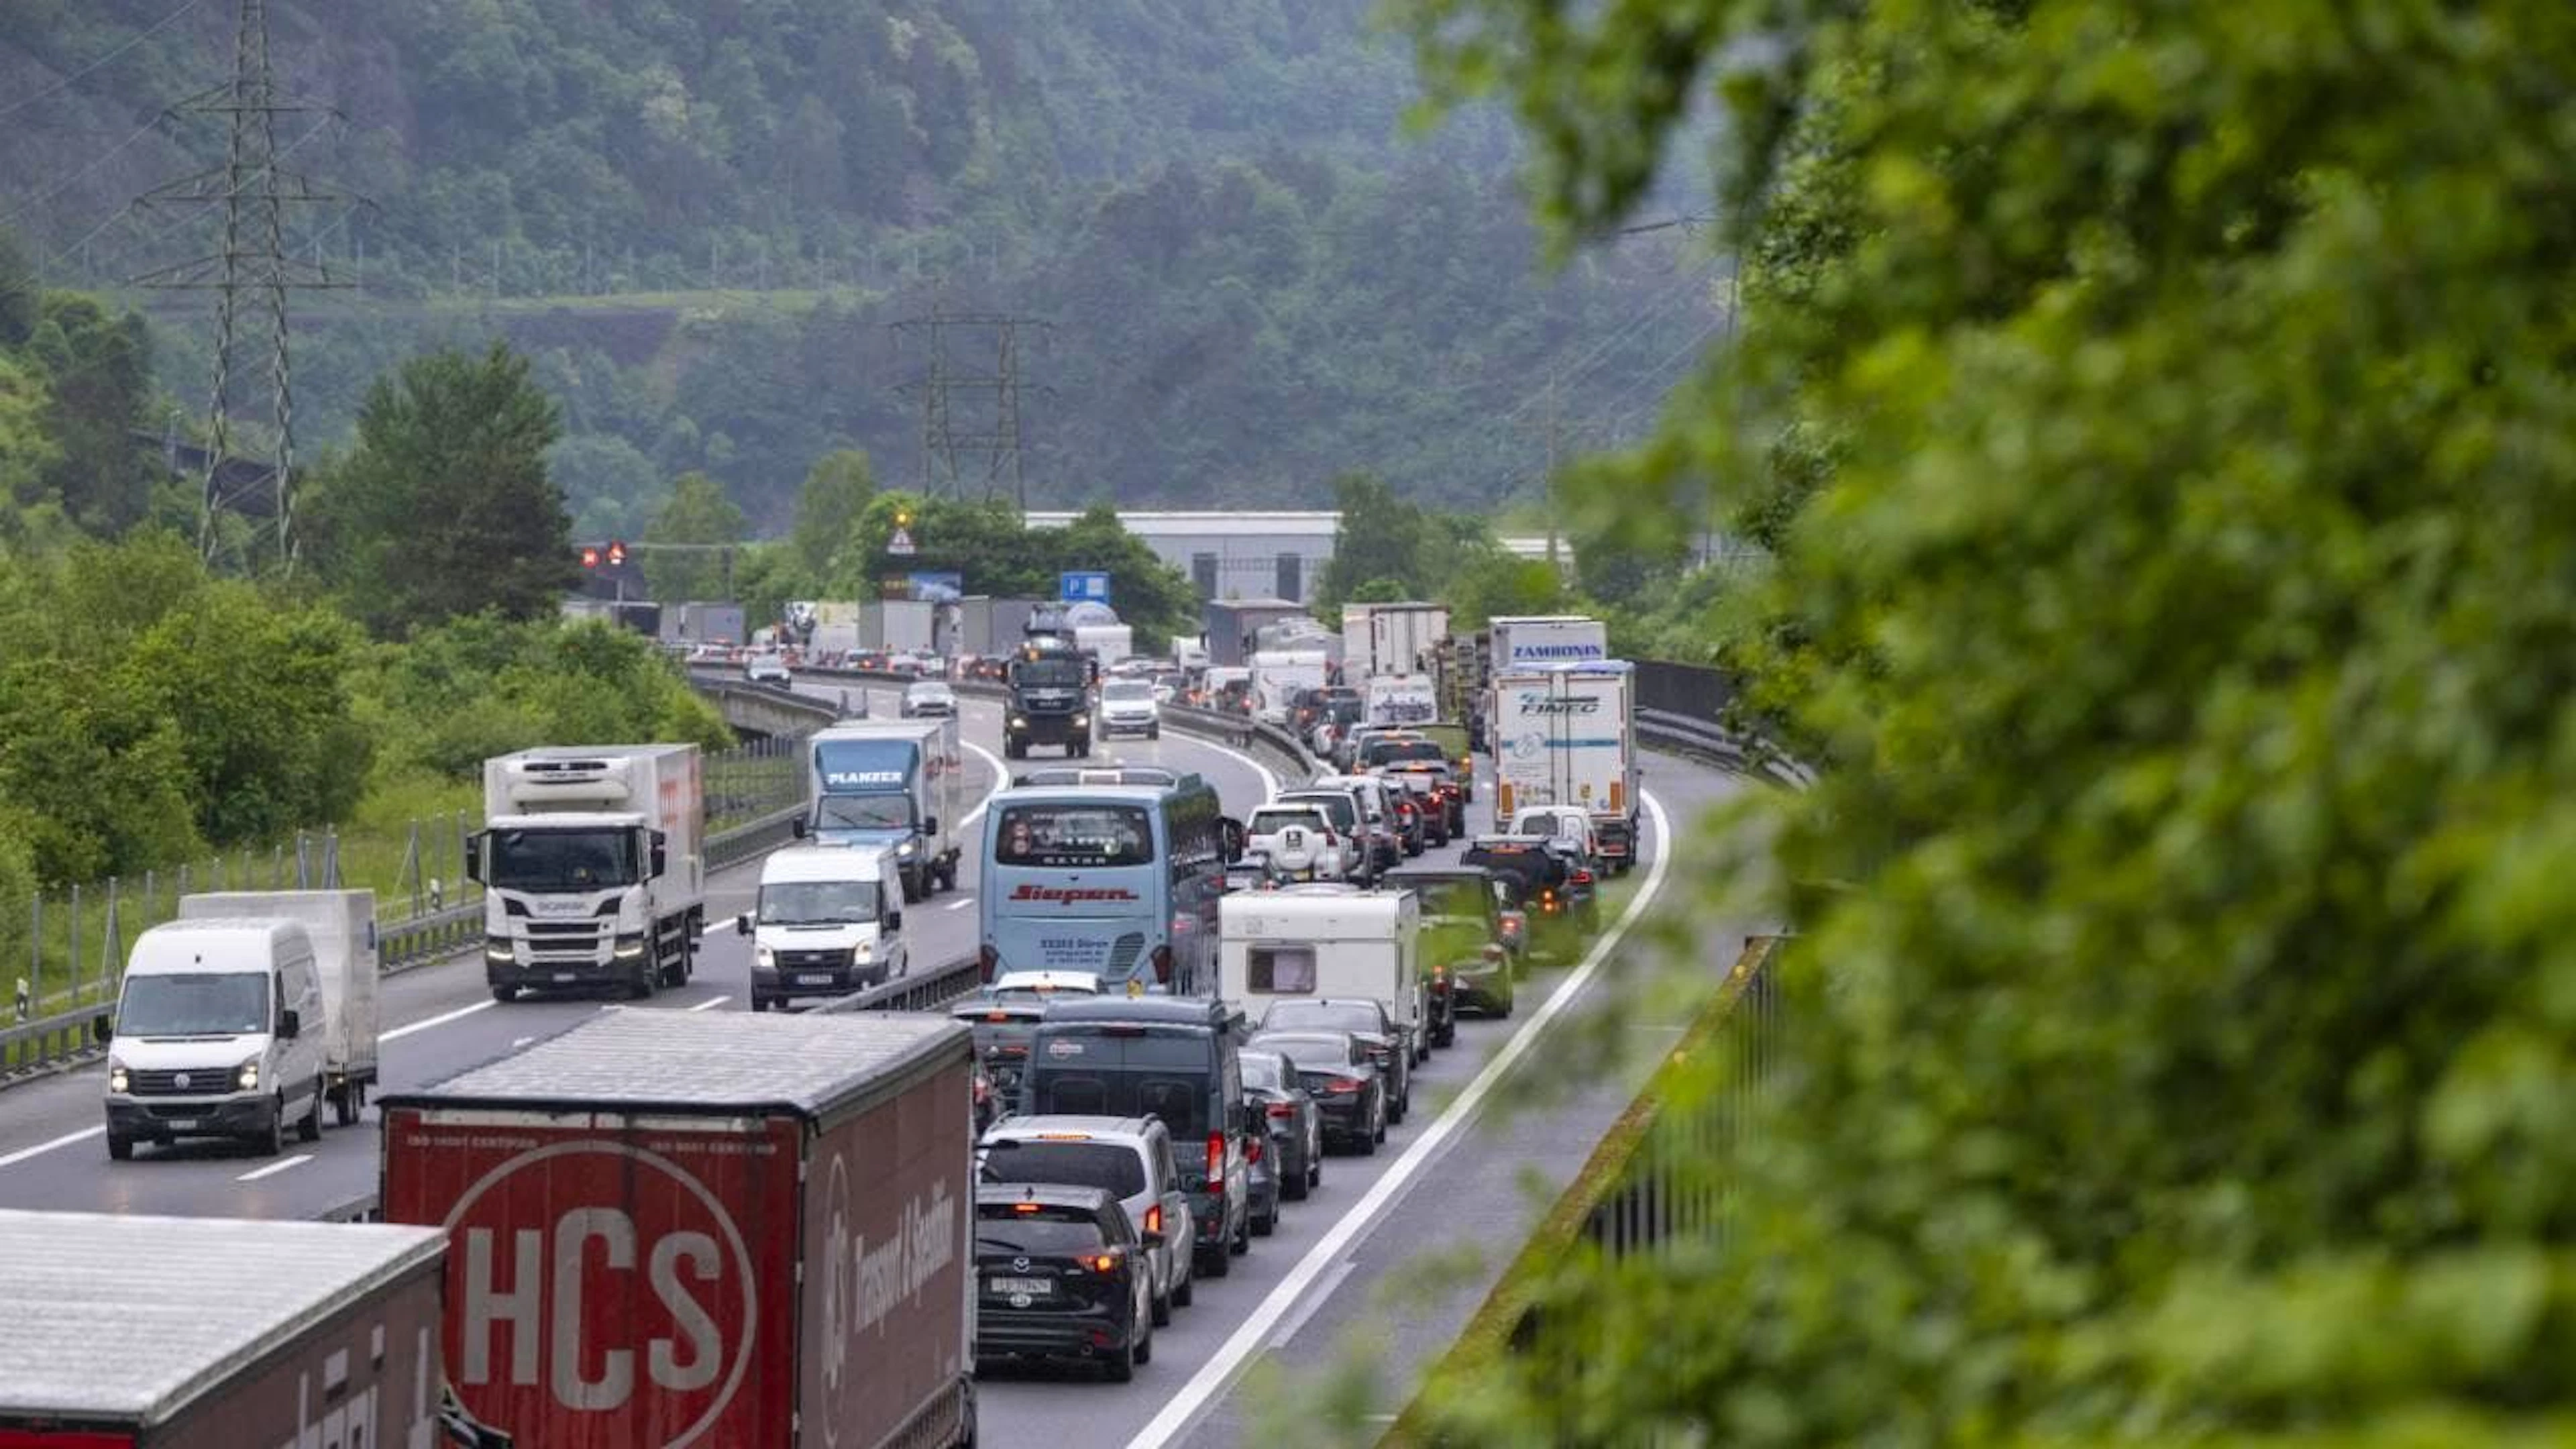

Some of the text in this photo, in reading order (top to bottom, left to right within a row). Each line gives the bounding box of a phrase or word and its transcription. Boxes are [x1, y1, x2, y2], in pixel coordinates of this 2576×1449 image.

[1513, 644, 1602, 658] ZAMBONIN
[827, 771, 903, 784] PLANZER
[463, 1206, 722, 1411] HCS
